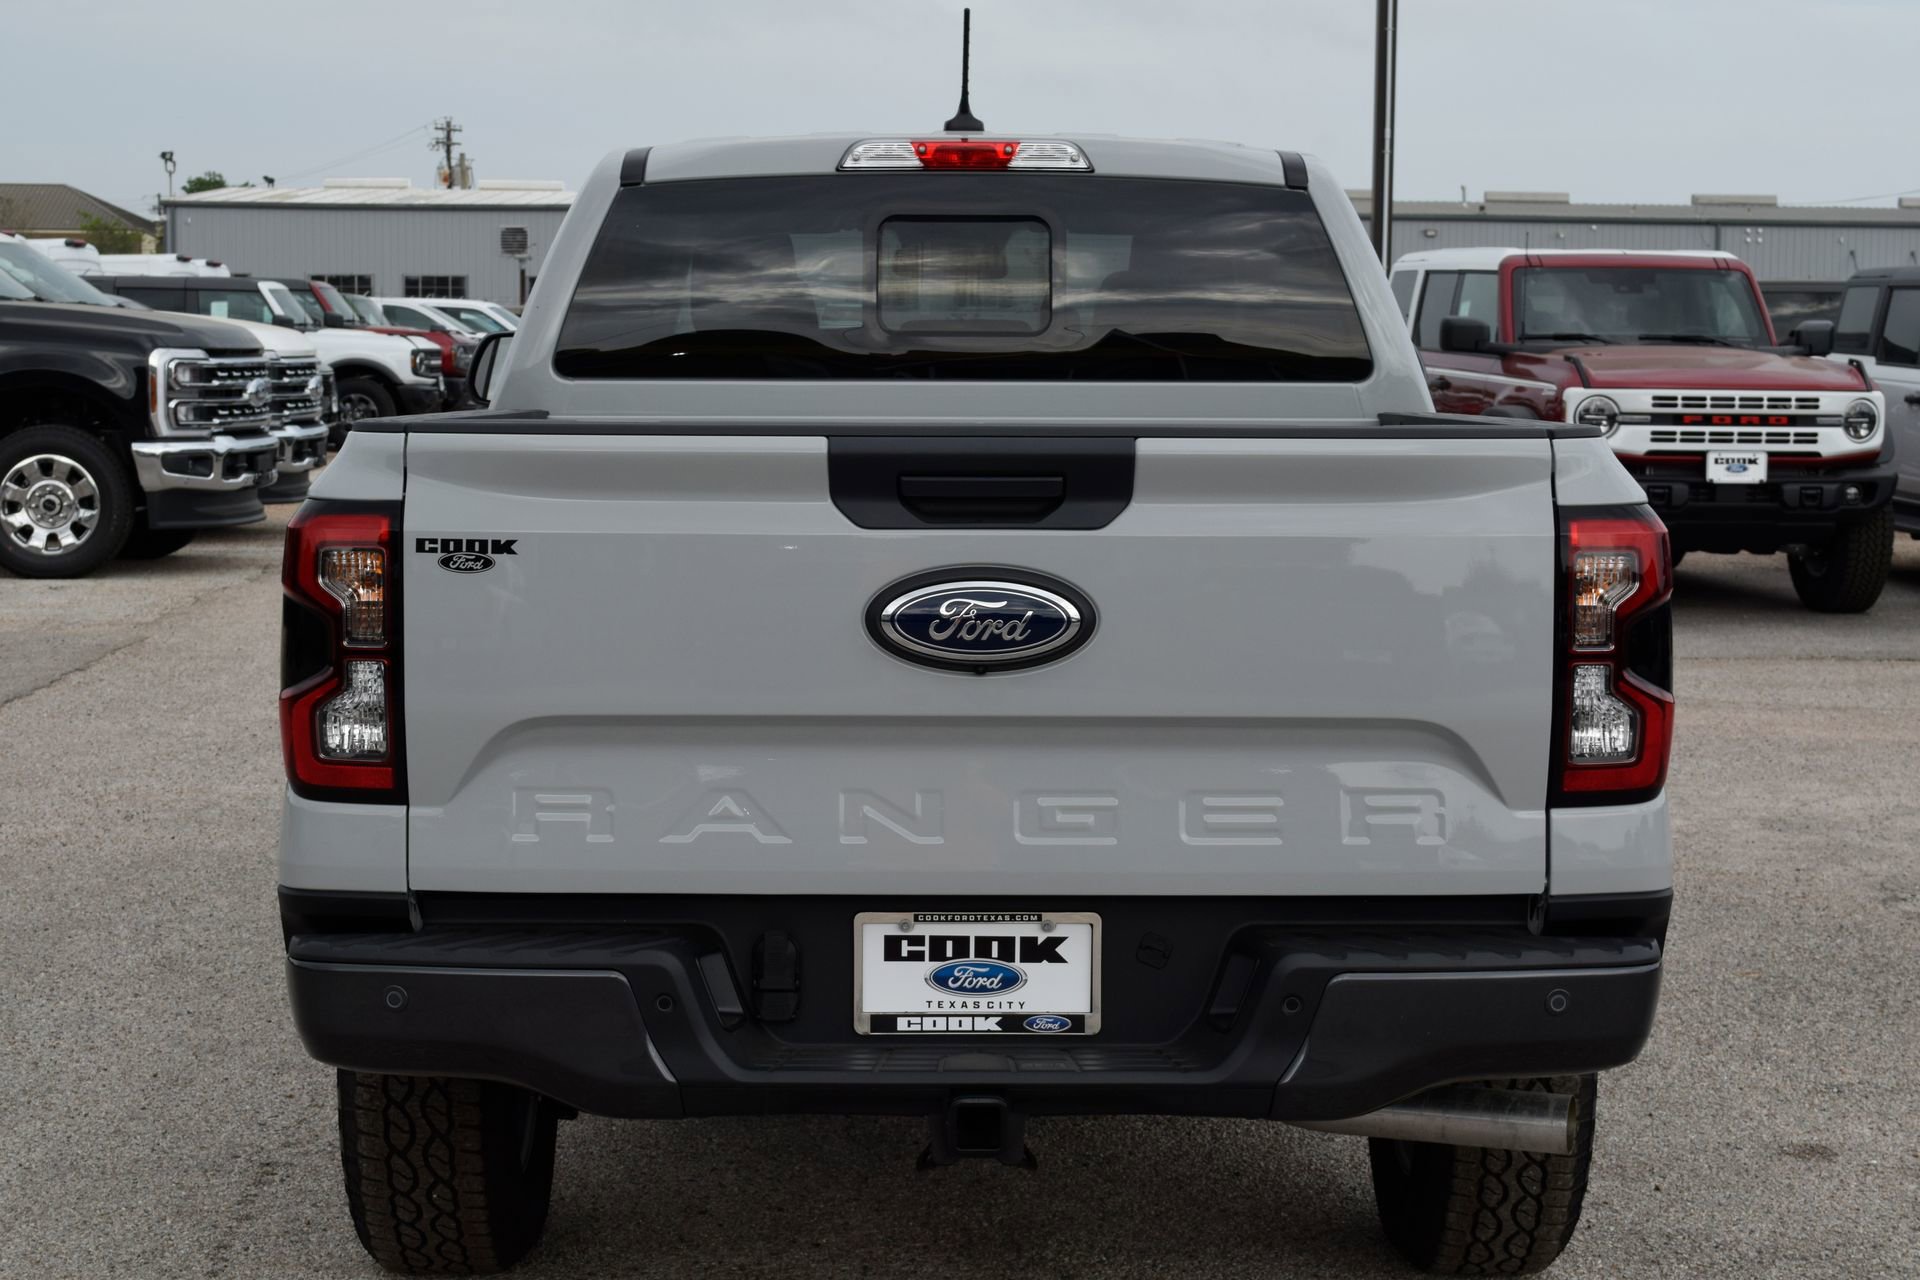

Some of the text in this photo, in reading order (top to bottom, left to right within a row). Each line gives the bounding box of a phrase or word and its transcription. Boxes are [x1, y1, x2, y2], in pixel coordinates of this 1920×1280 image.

[1683, 415, 1788, 425] FORD
[416, 538, 519, 555] COOK
[449, 555, 484, 569] Ford
[929, 598, 1034, 641] Ford
[510, 788, 1448, 847] RANGER
[918, 914, 1039, 922] COOKFORDTEXAS.COM
[883, 934, 1069, 964] COOK
[947, 966, 1003, 989] Ford
[896, 1016, 1060, 1031] COOK Ford
